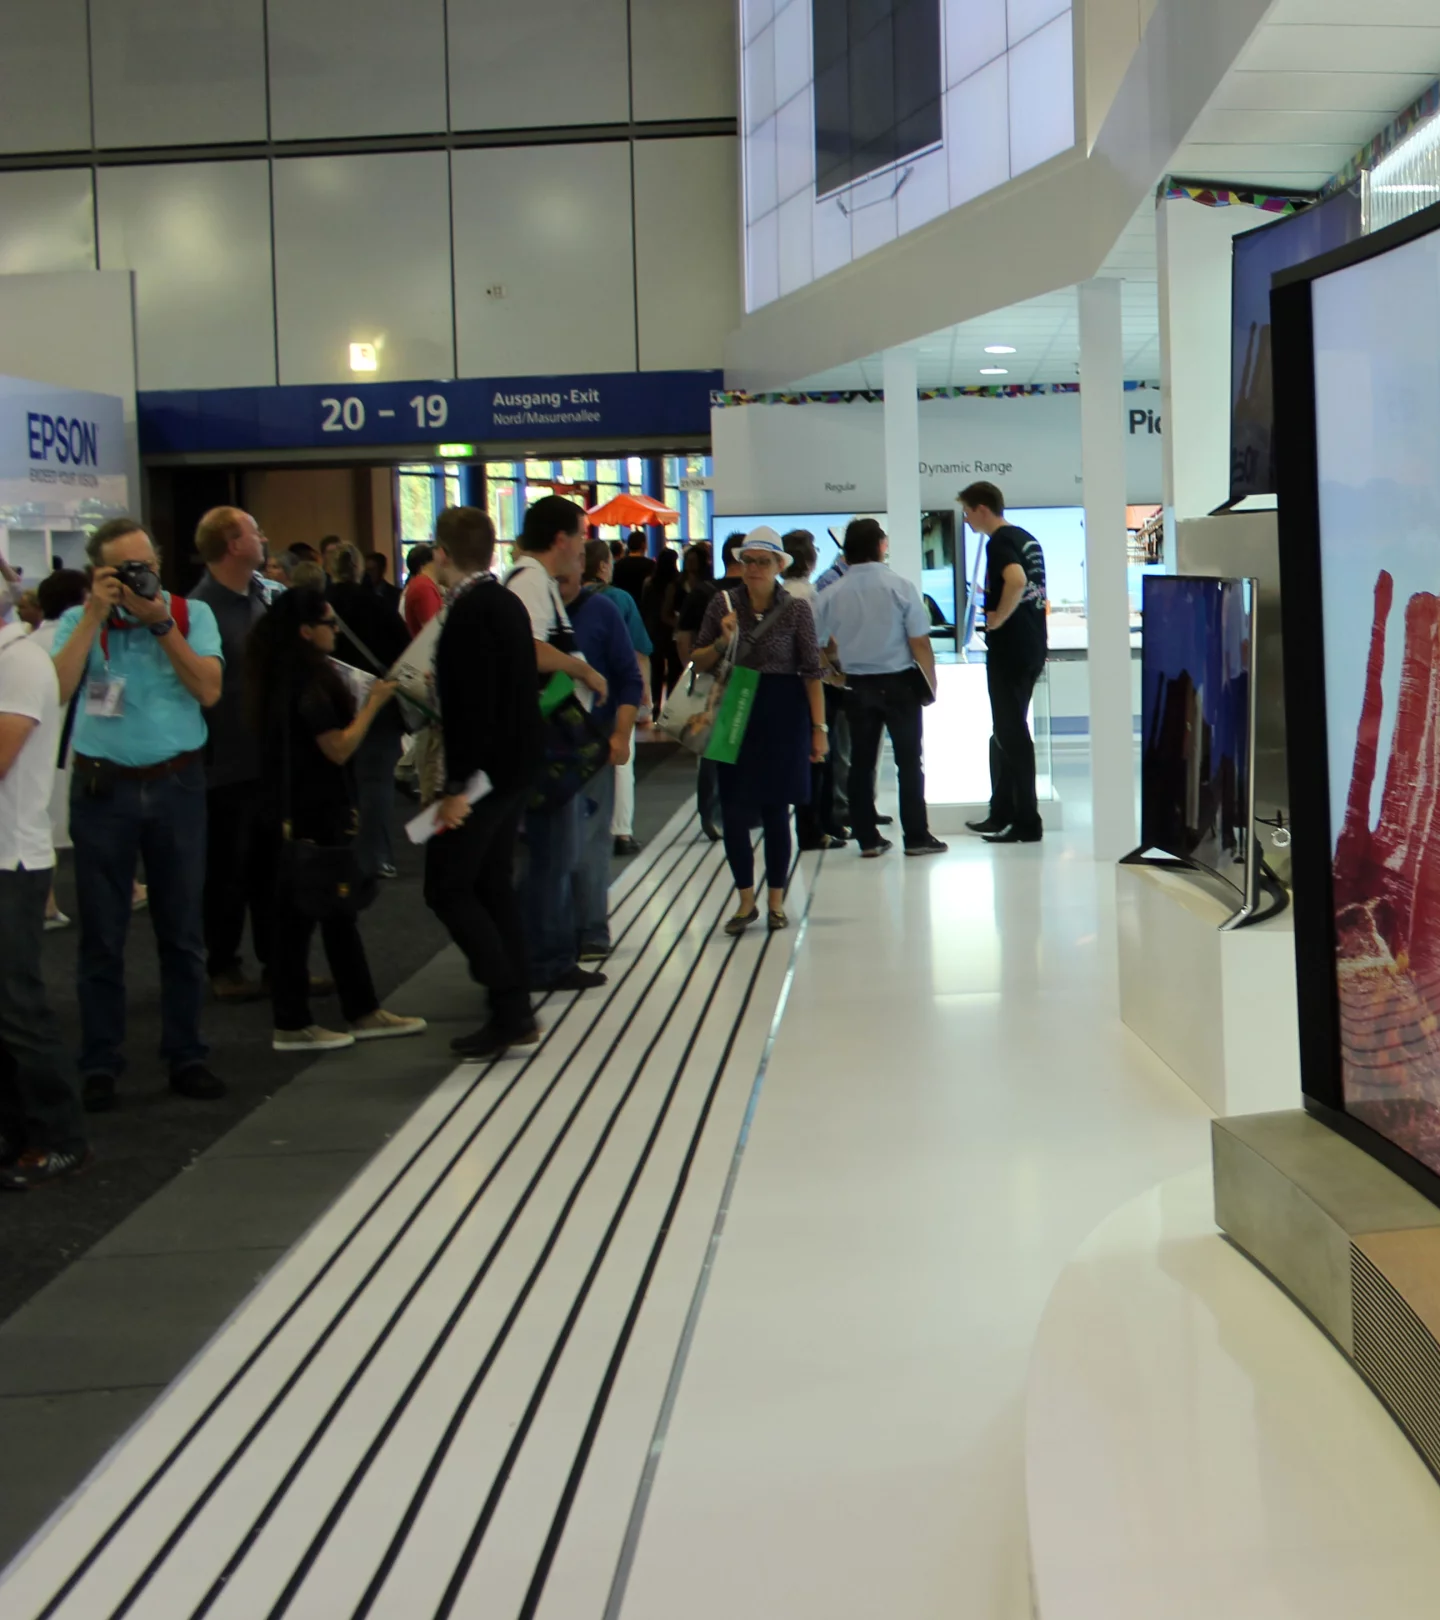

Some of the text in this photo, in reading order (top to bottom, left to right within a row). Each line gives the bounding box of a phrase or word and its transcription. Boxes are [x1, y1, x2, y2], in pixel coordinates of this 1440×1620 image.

[493, 387, 600, 409] Ausgang Exit
[321, 397, 365, 432] 20
[409, 394, 448, 429] 19
[27, 411, 98, 467] EPSON
[918, 460, 1013, 477] Dynamic Range
[825, 482, 857, 493] Regular
